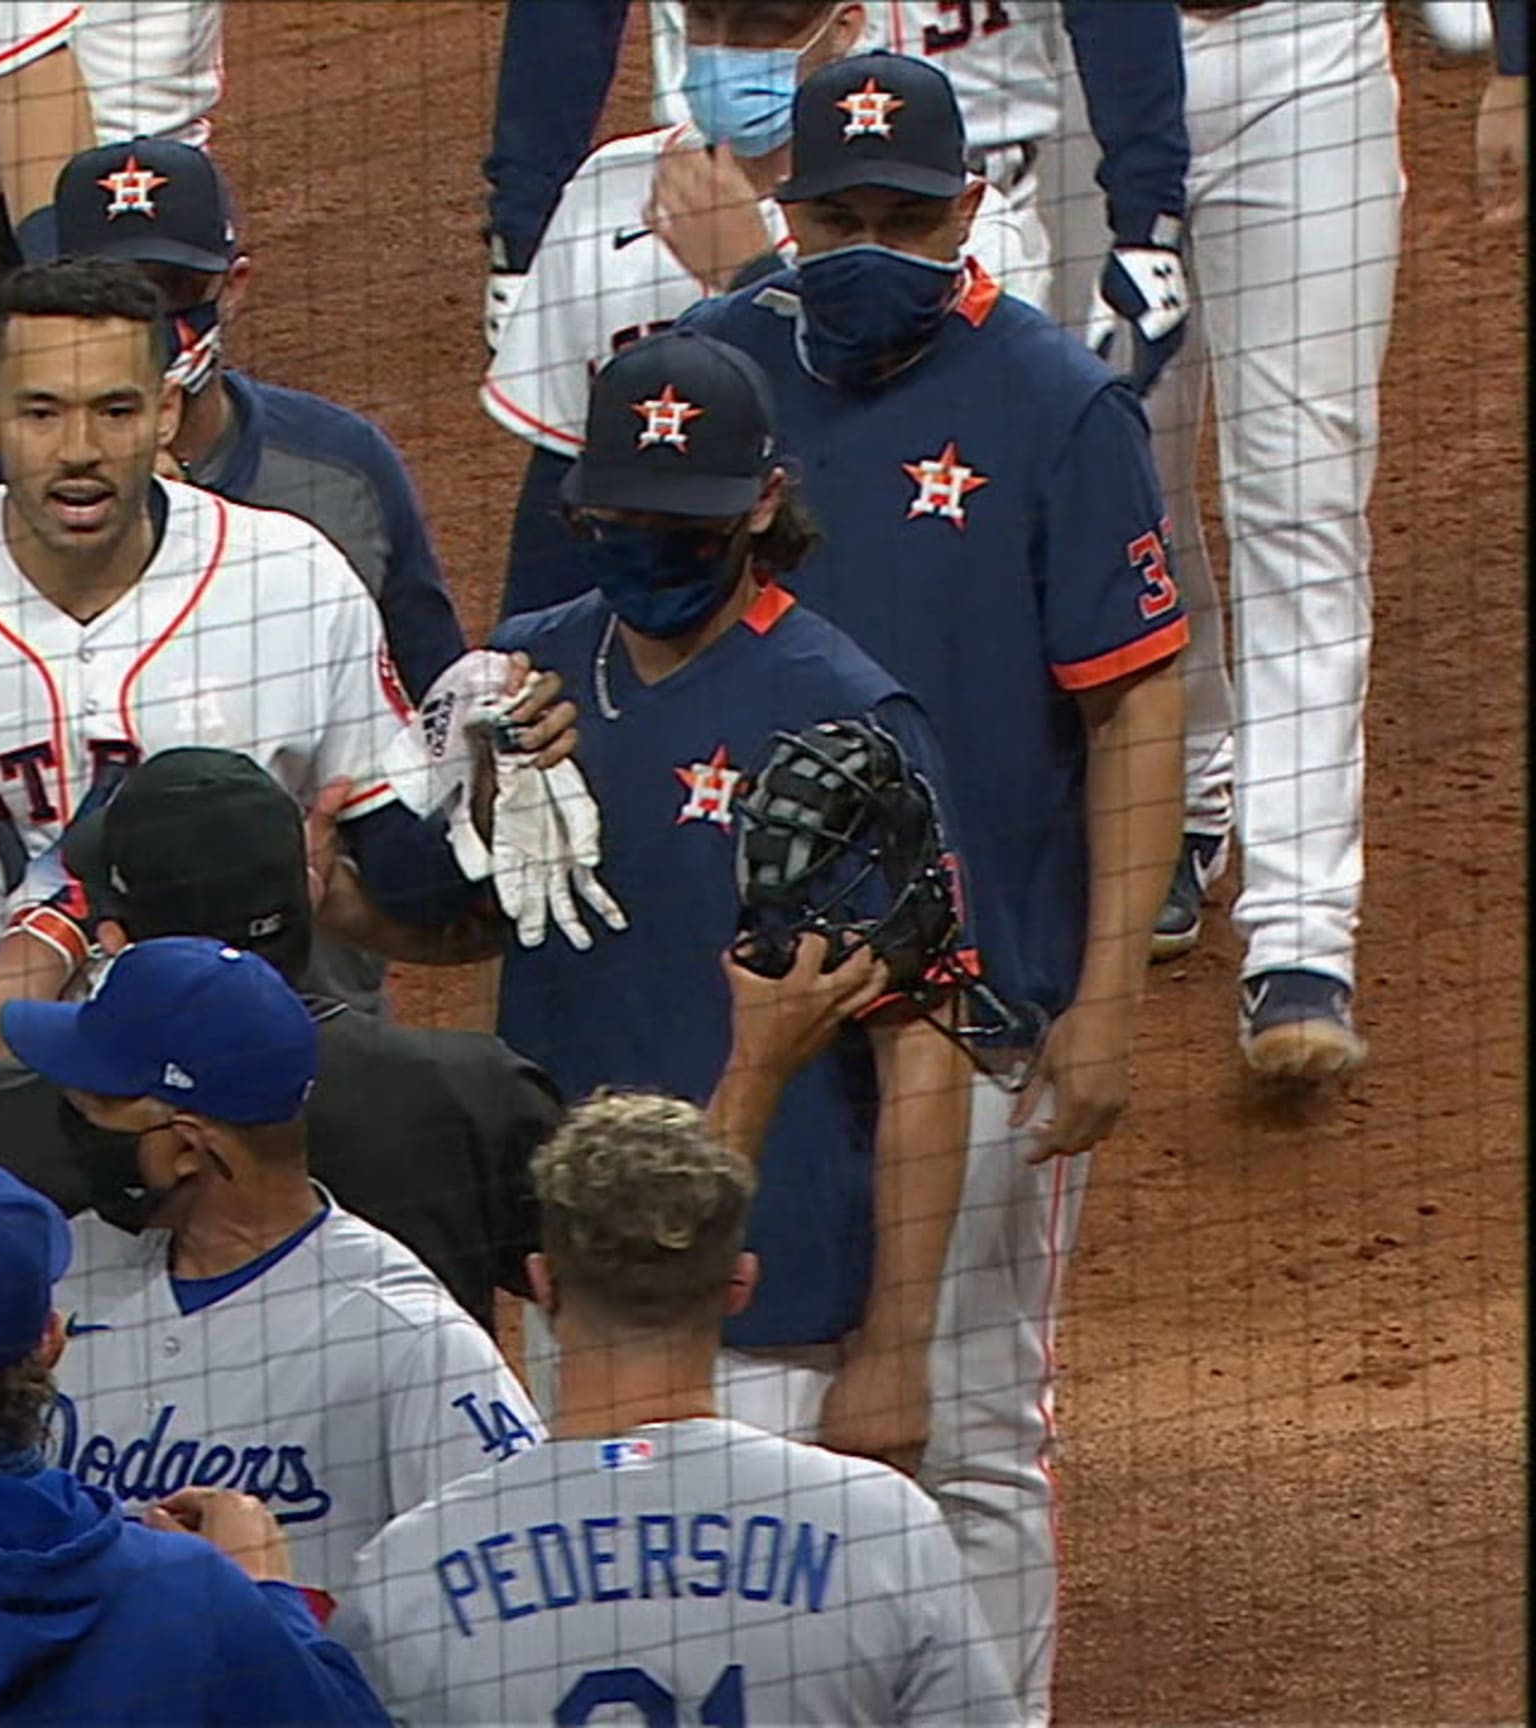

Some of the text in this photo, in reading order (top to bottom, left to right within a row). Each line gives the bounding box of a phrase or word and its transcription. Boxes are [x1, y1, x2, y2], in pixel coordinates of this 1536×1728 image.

[844, 93, 896, 135] H
[107, 172, 156, 214] H
[639, 400, 692, 443] H
[908, 460, 967, 519] H
[1127, 516, 1177, 620] 3
[680, 764, 741, 822] H
[451, 1392, 536, 1462] LA
[435, 1513, 839, 1637] PEDERSON
